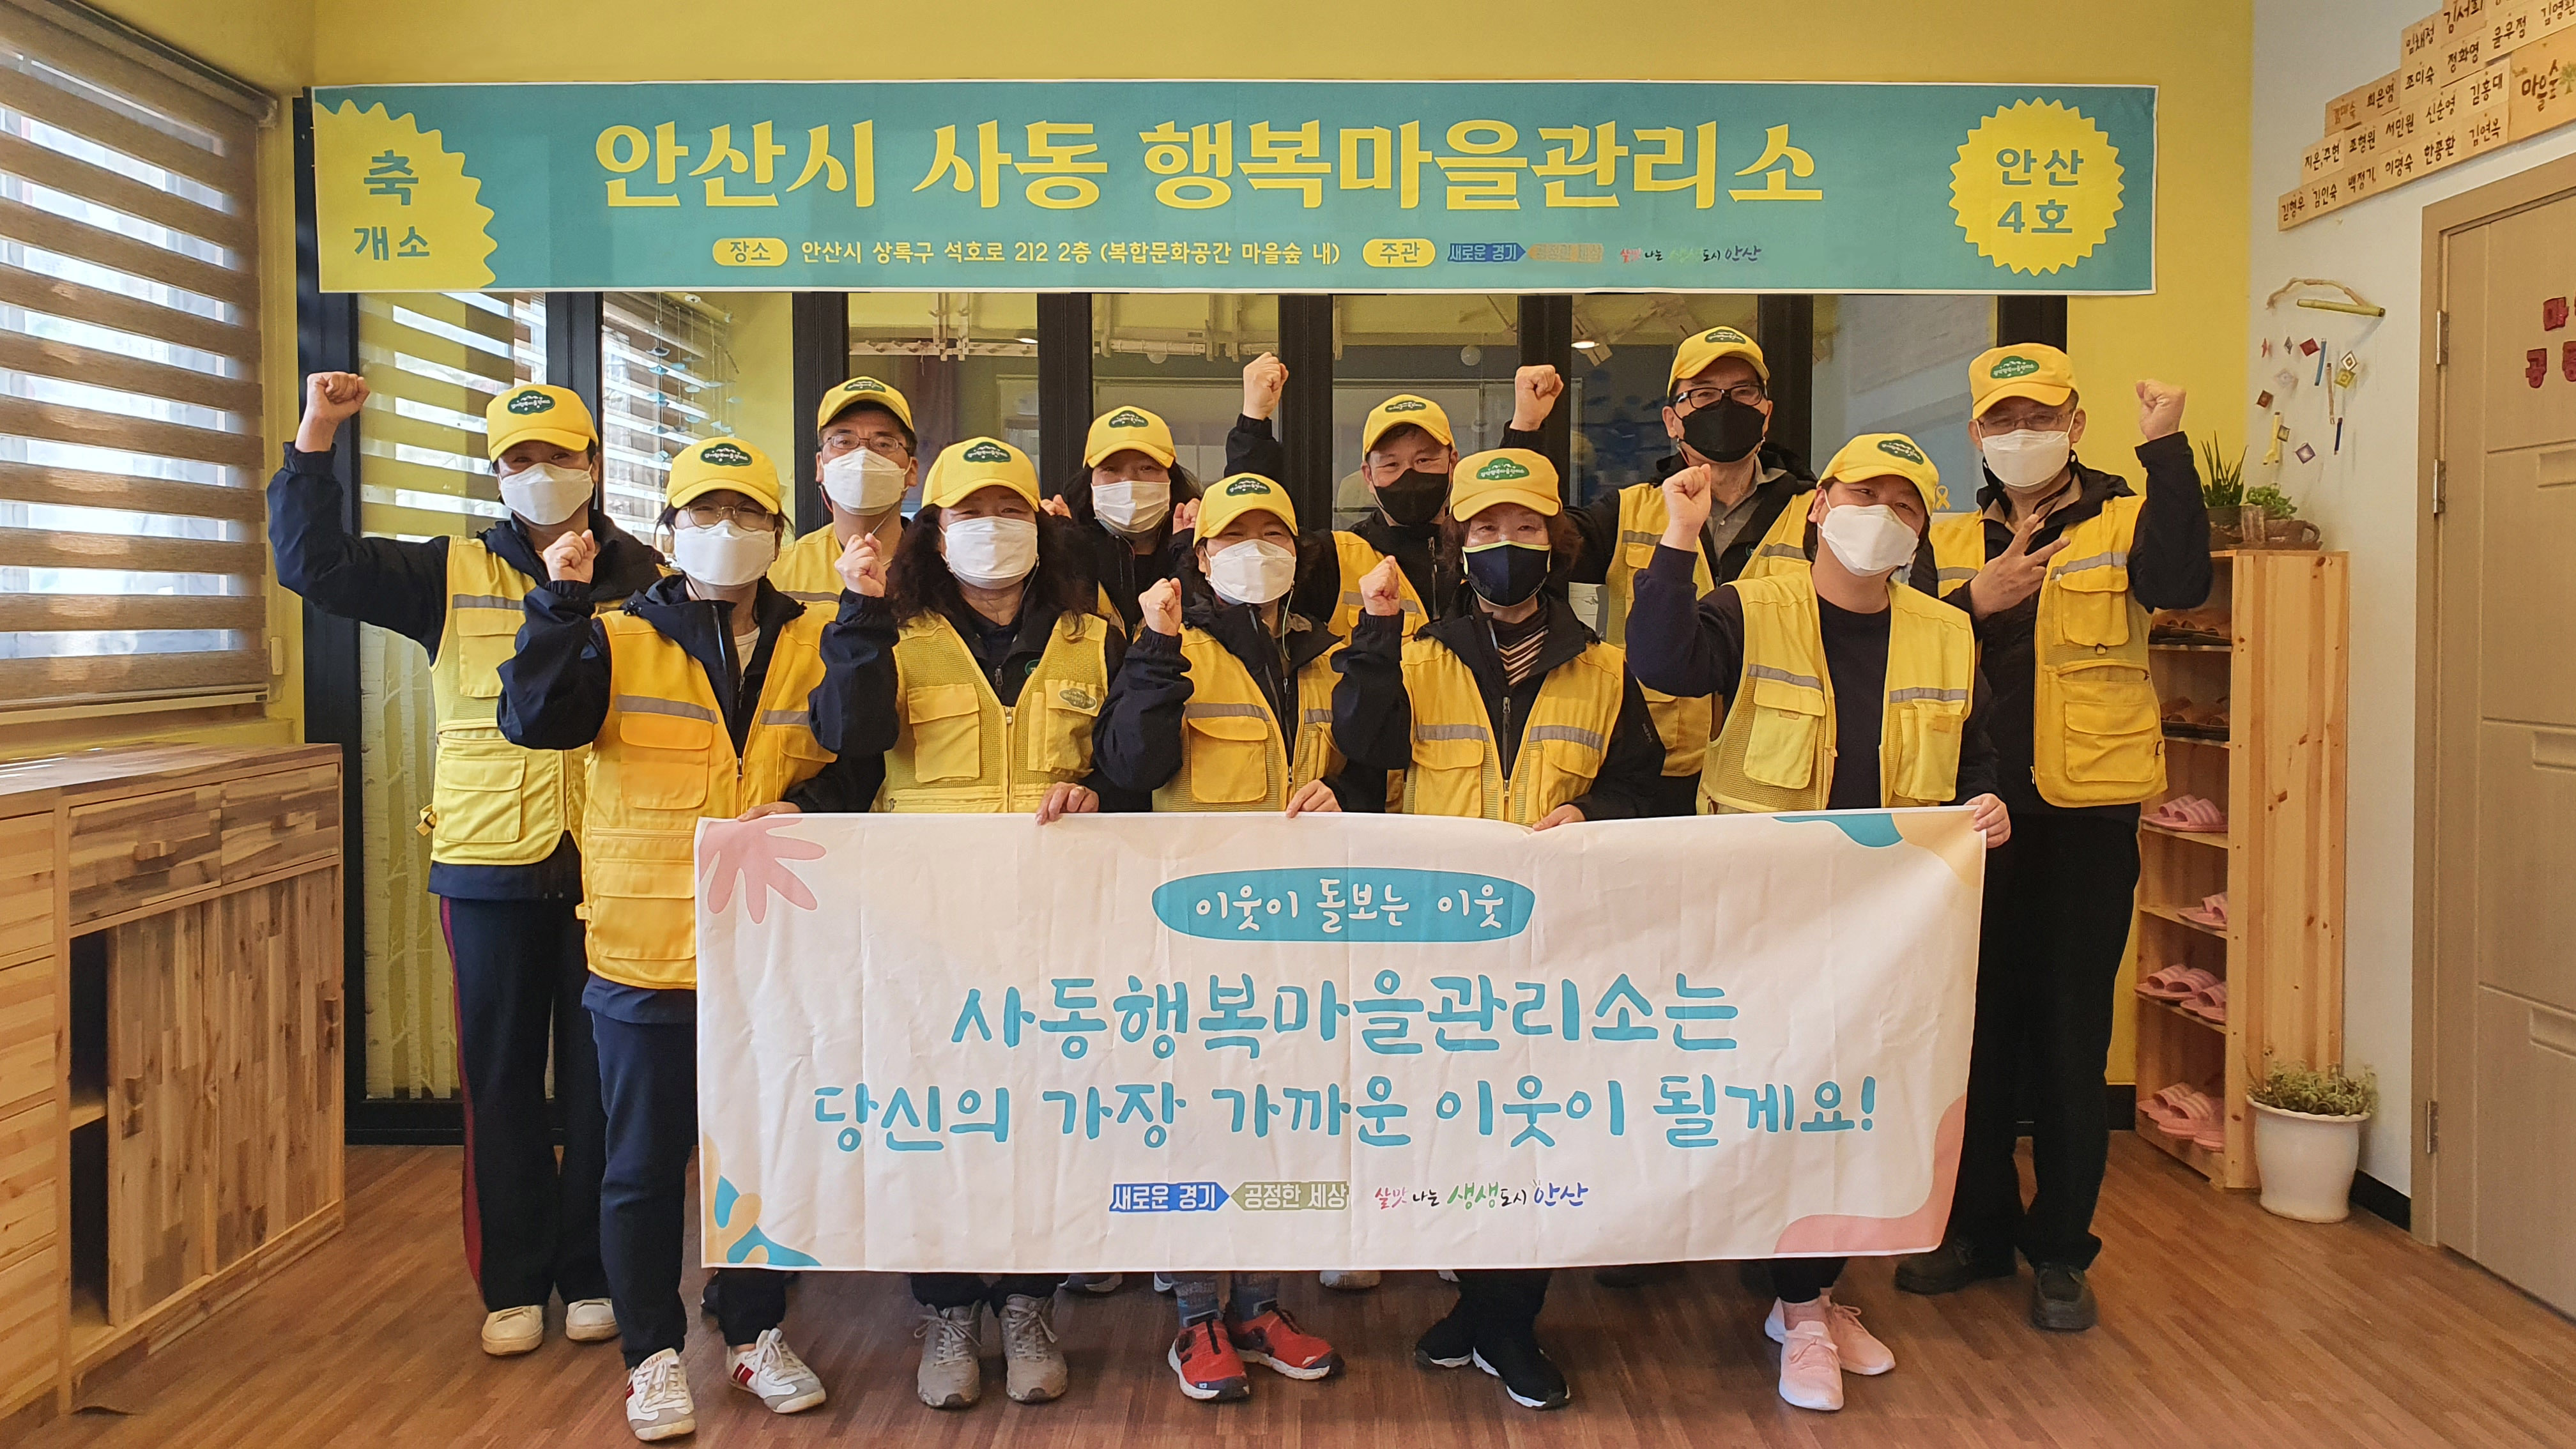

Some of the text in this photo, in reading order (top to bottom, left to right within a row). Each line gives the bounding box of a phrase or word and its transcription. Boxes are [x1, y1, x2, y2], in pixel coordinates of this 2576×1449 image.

[2405, 66, 2435, 90] 조미숙
[2448, 41, 2479, 73] 정화영
[2386, 113, 2414, 138] 서민원
[2426, 95, 2455, 124] 신순영
[364, 149, 419, 206] 축
[594, 119, 1825, 209] 안산시 사동 행복마을관리소
[1996, 148, 2084, 186] 안산
[2313, 184, 2337, 208] 김인숙
[2385, 153, 2413, 177] 이명숙
[2424, 135, 2455, 165] 한종환
[2469, 118, 2501, 147] 김연옥
[1997, 199, 2073, 233] 4호
[354, 226, 430, 261] 개소
[730, 240, 1420, 265] 장소 안산시 상록구 석호로 212 2층 (복합문화공간 마을숲 내) 주관
[1450, 244, 1486, 261] 새로운
[1492, 244, 1517, 261] 경기
[1644, 250, 1663, 261] 나는
[1725, 245, 1761, 261] 안산
[1195, 878, 1504, 933] 이웃이 돌보는 이웃
[951, 969, 1739, 1060] 사동행복마을관리소는
[815, 1075, 1876, 1152] 당신의 가장 가까운 이웃이 될게요!
[1112, 1183, 1347, 1209] 새로운 경기 공정한 세상
[1375, 1186, 1407, 1209] 살맛
[1413, 1189, 1440, 1207] 나는
[1534, 1182, 1589, 1206] 안산
